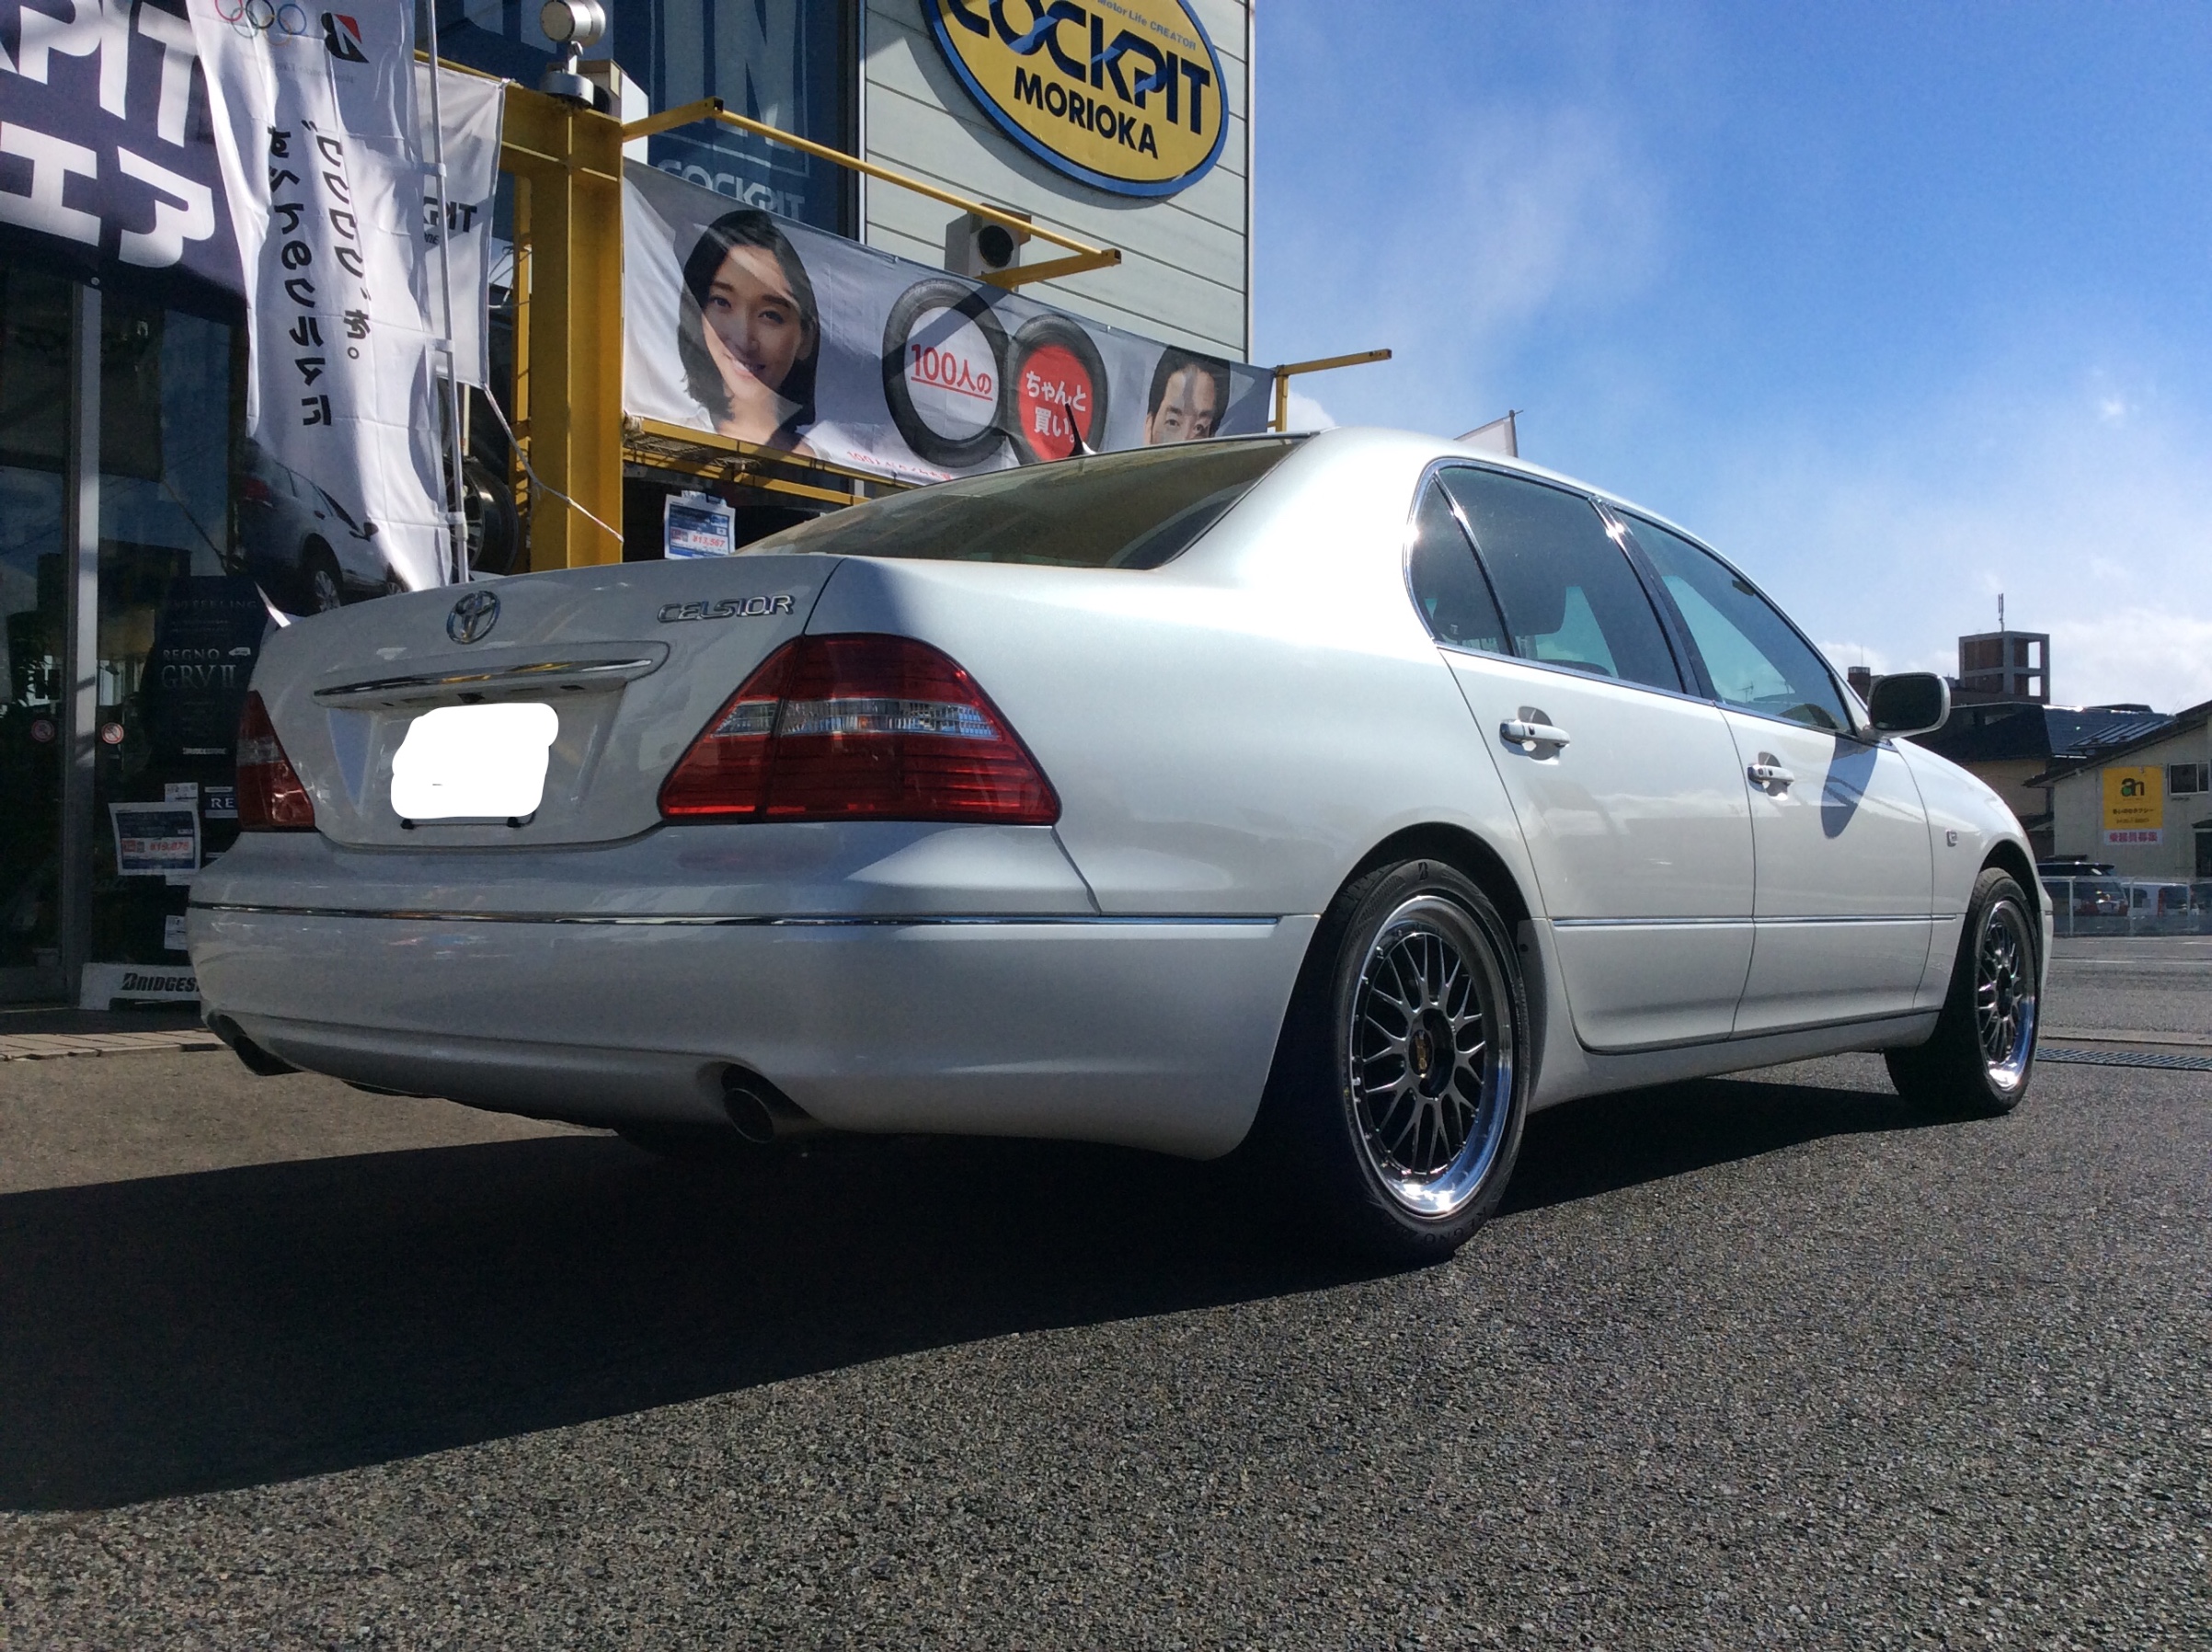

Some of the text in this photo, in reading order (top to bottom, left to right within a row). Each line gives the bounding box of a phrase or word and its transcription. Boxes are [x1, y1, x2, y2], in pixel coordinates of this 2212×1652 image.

[1129, 9, 1148, 27] Life
[1150, 20, 1197, 51] CREATOR
[1014, 65, 1158, 160] MORIOKA
[911, 343, 992, 395] 100人の
[1026, 370, 1087, 412] ちゃんと
[657, 594, 796, 624] CELSIOR
[162, 648, 221, 662] REGNO
[120, 972, 200, 992] BRIDGES
